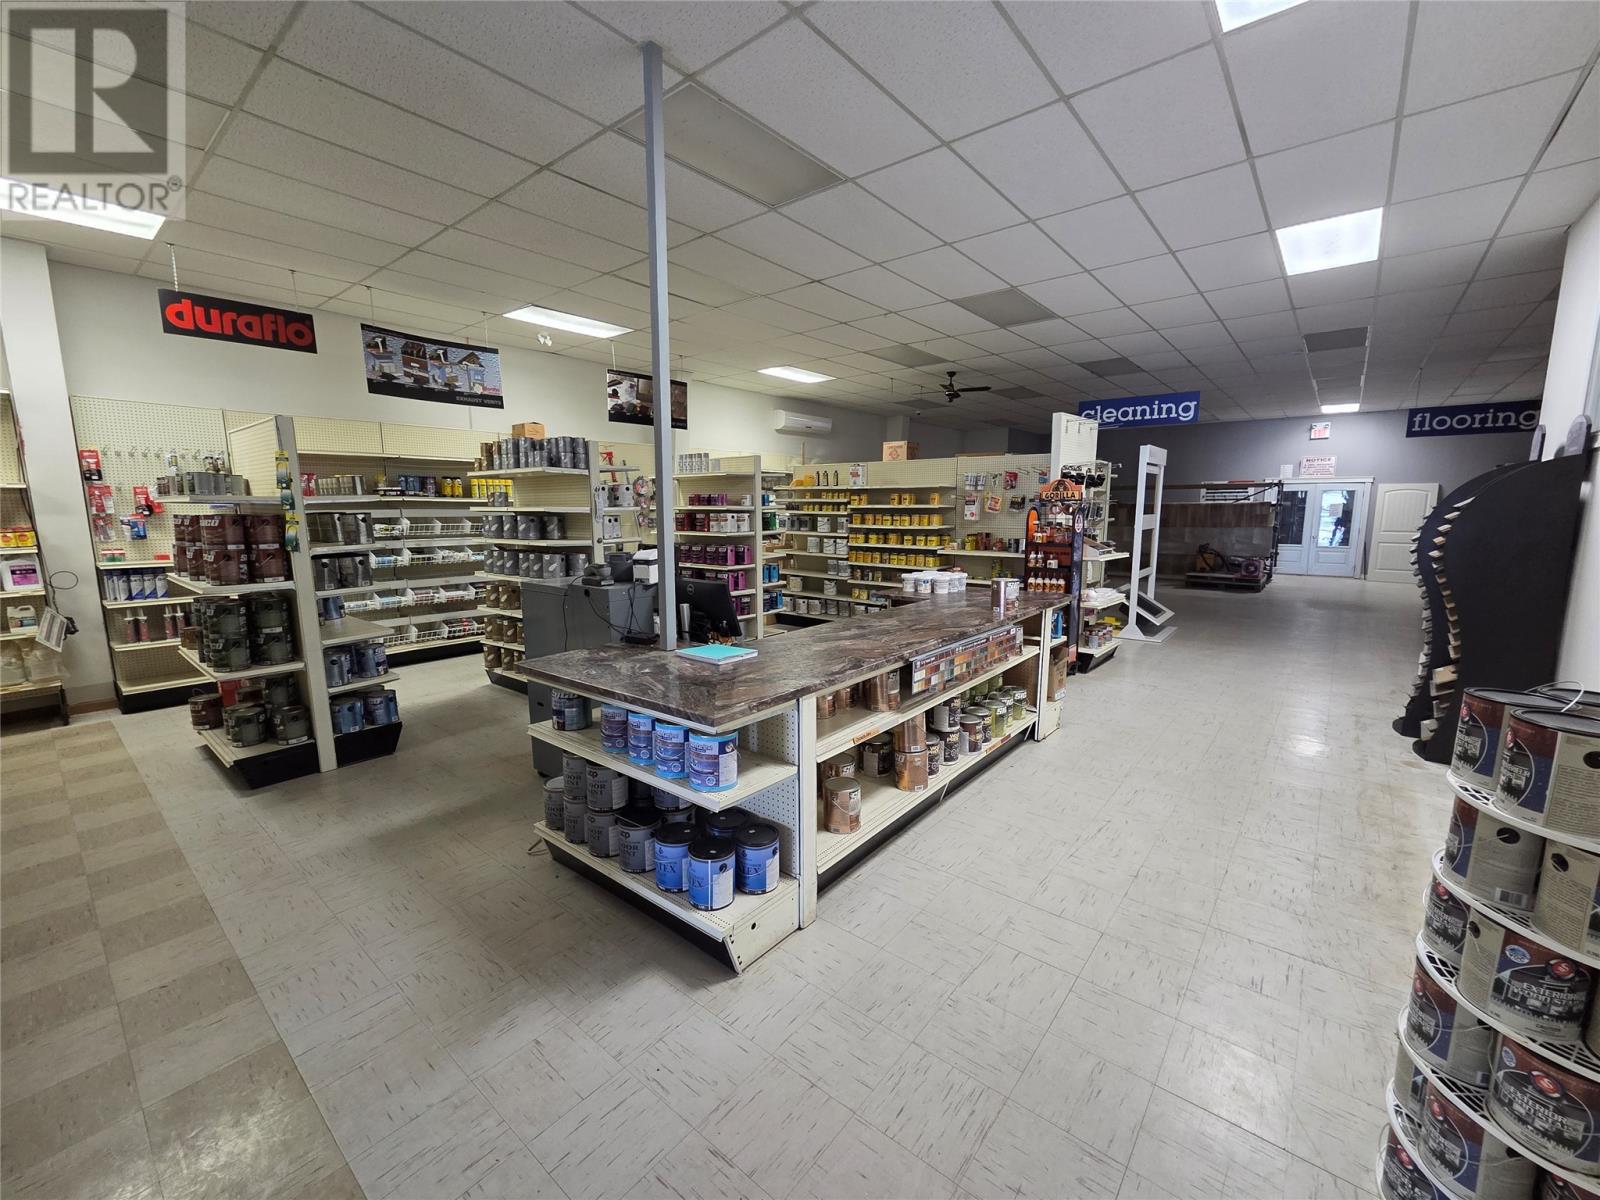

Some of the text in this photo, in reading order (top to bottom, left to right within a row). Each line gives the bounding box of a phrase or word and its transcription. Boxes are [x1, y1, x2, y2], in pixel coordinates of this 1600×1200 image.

[165, 299, 313, 346] duraflo
[1081, 400, 1197, 422] cleaning
[1411, 408, 1540, 431] flooring
[1044, 490, 1077, 499] GORILLA
[1522, 982, 1577, 1001] EXTERIOR
